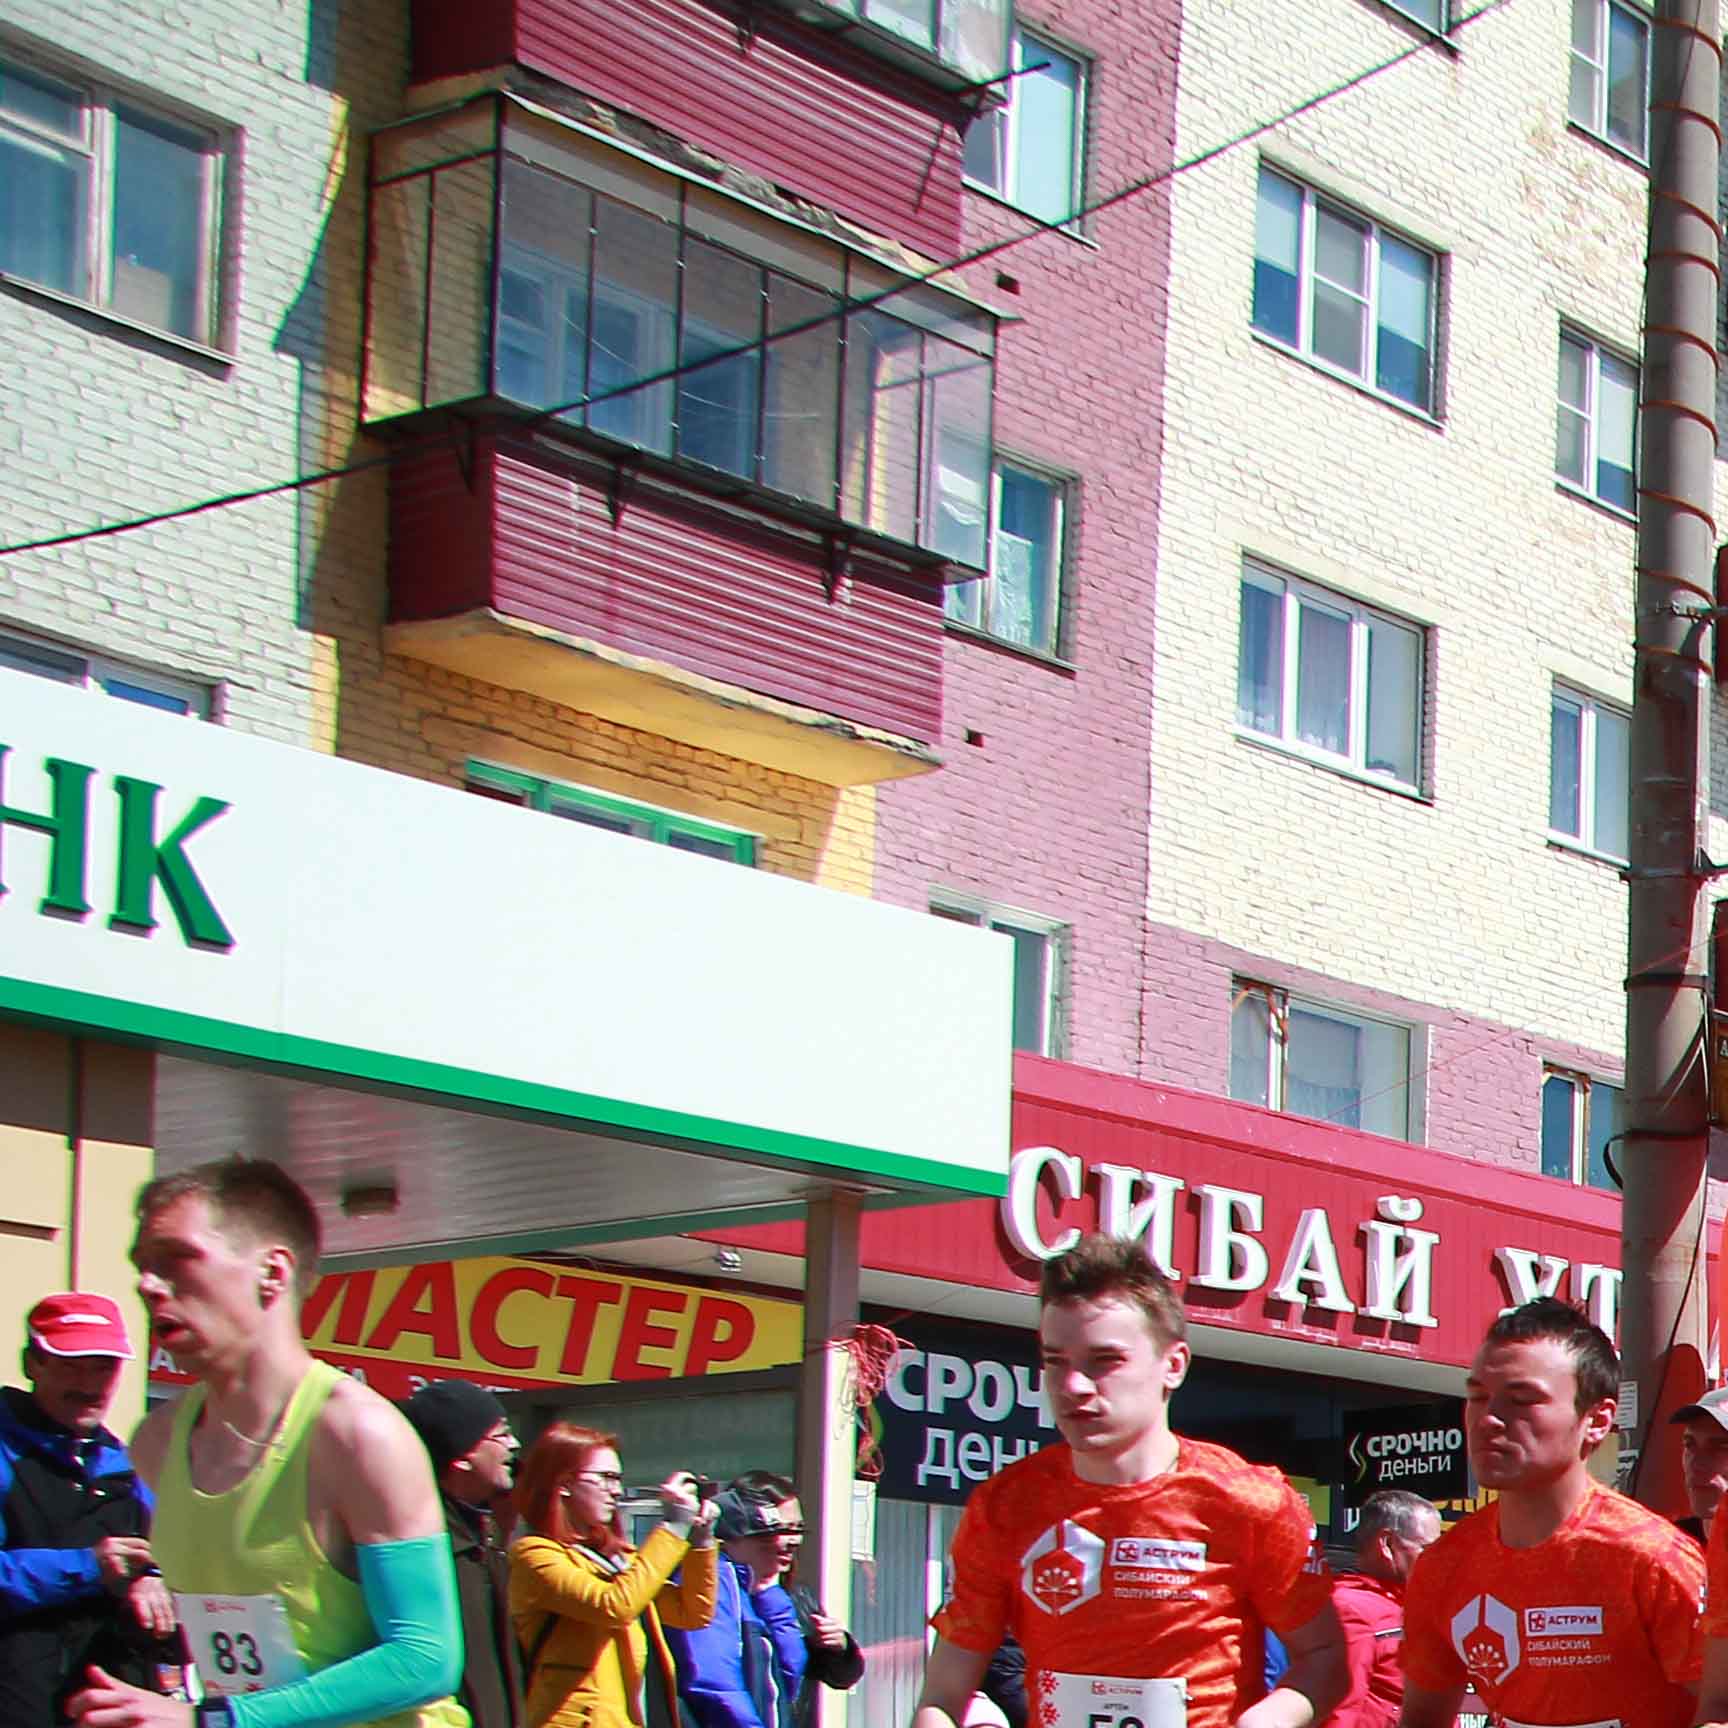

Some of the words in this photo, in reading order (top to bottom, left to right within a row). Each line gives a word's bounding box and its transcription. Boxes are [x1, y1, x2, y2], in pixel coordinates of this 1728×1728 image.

[1003, 1145, 1439, 1328] СИБАЙ
[884, 1348, 1057, 1429] СРОЧ
[916, 1427, 1040, 1490] ден
[1366, 1428, 1463, 1458] СРОЧНО
[1378, 1455, 1452, 1482] деньги
[1547, 1615, 1598, 1626] АСТРУМ
[211, 1631, 264, 1676] 83
